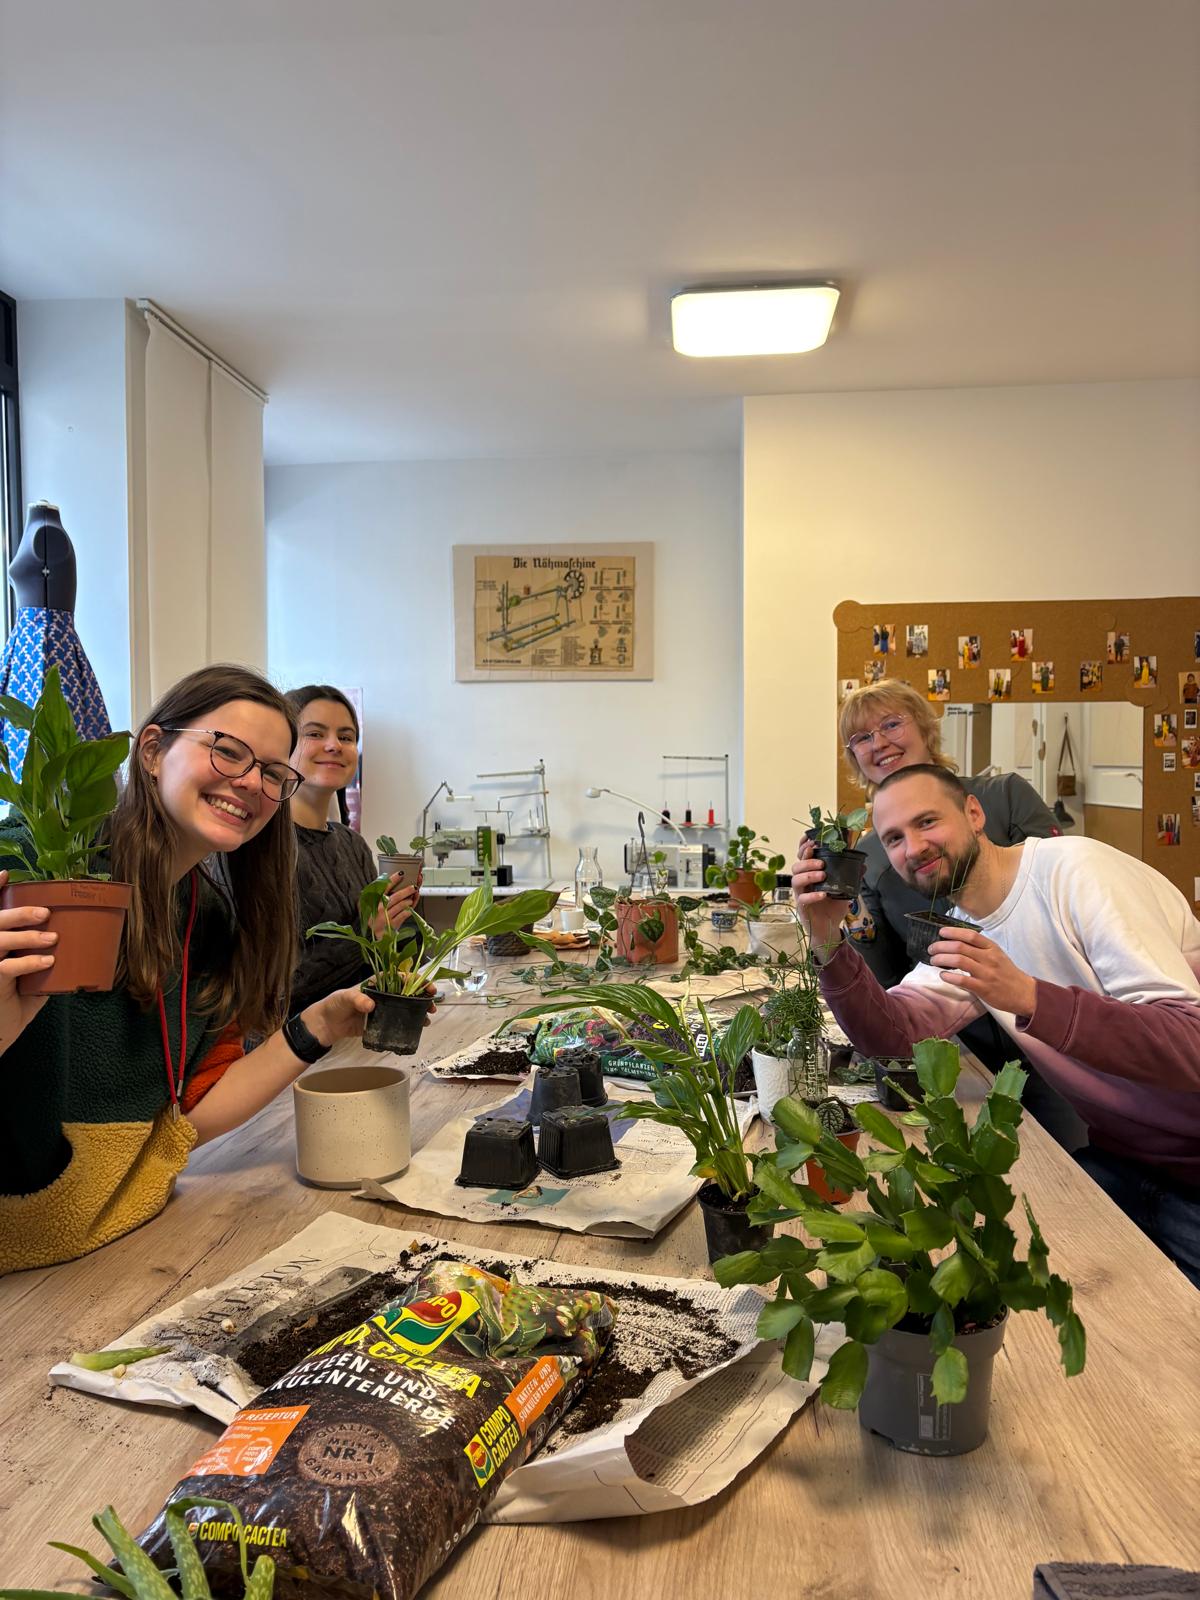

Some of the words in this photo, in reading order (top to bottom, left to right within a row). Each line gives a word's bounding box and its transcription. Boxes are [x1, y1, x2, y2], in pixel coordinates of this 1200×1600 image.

[513, 557, 528, 568] Die
[805, 1053, 816, 1084] fruits
[424, 1295, 457, 1319] MPO
[287, 1352, 376, 1377] AKTEEN-
[384, 1370, 437, 1400] UND
[368, 1341, 482, 1399] CACTEA
[246, 1411, 300, 1421] REZEPTUR
[480, 1405, 512, 1446] COMPO
[491, 1423, 520, 1468] CACTEA
[304, 1457, 386, 1480] GARANTIE
[199, 1521, 240, 1542] COMPO
[242, 1524, 287, 1547] CACTEA
